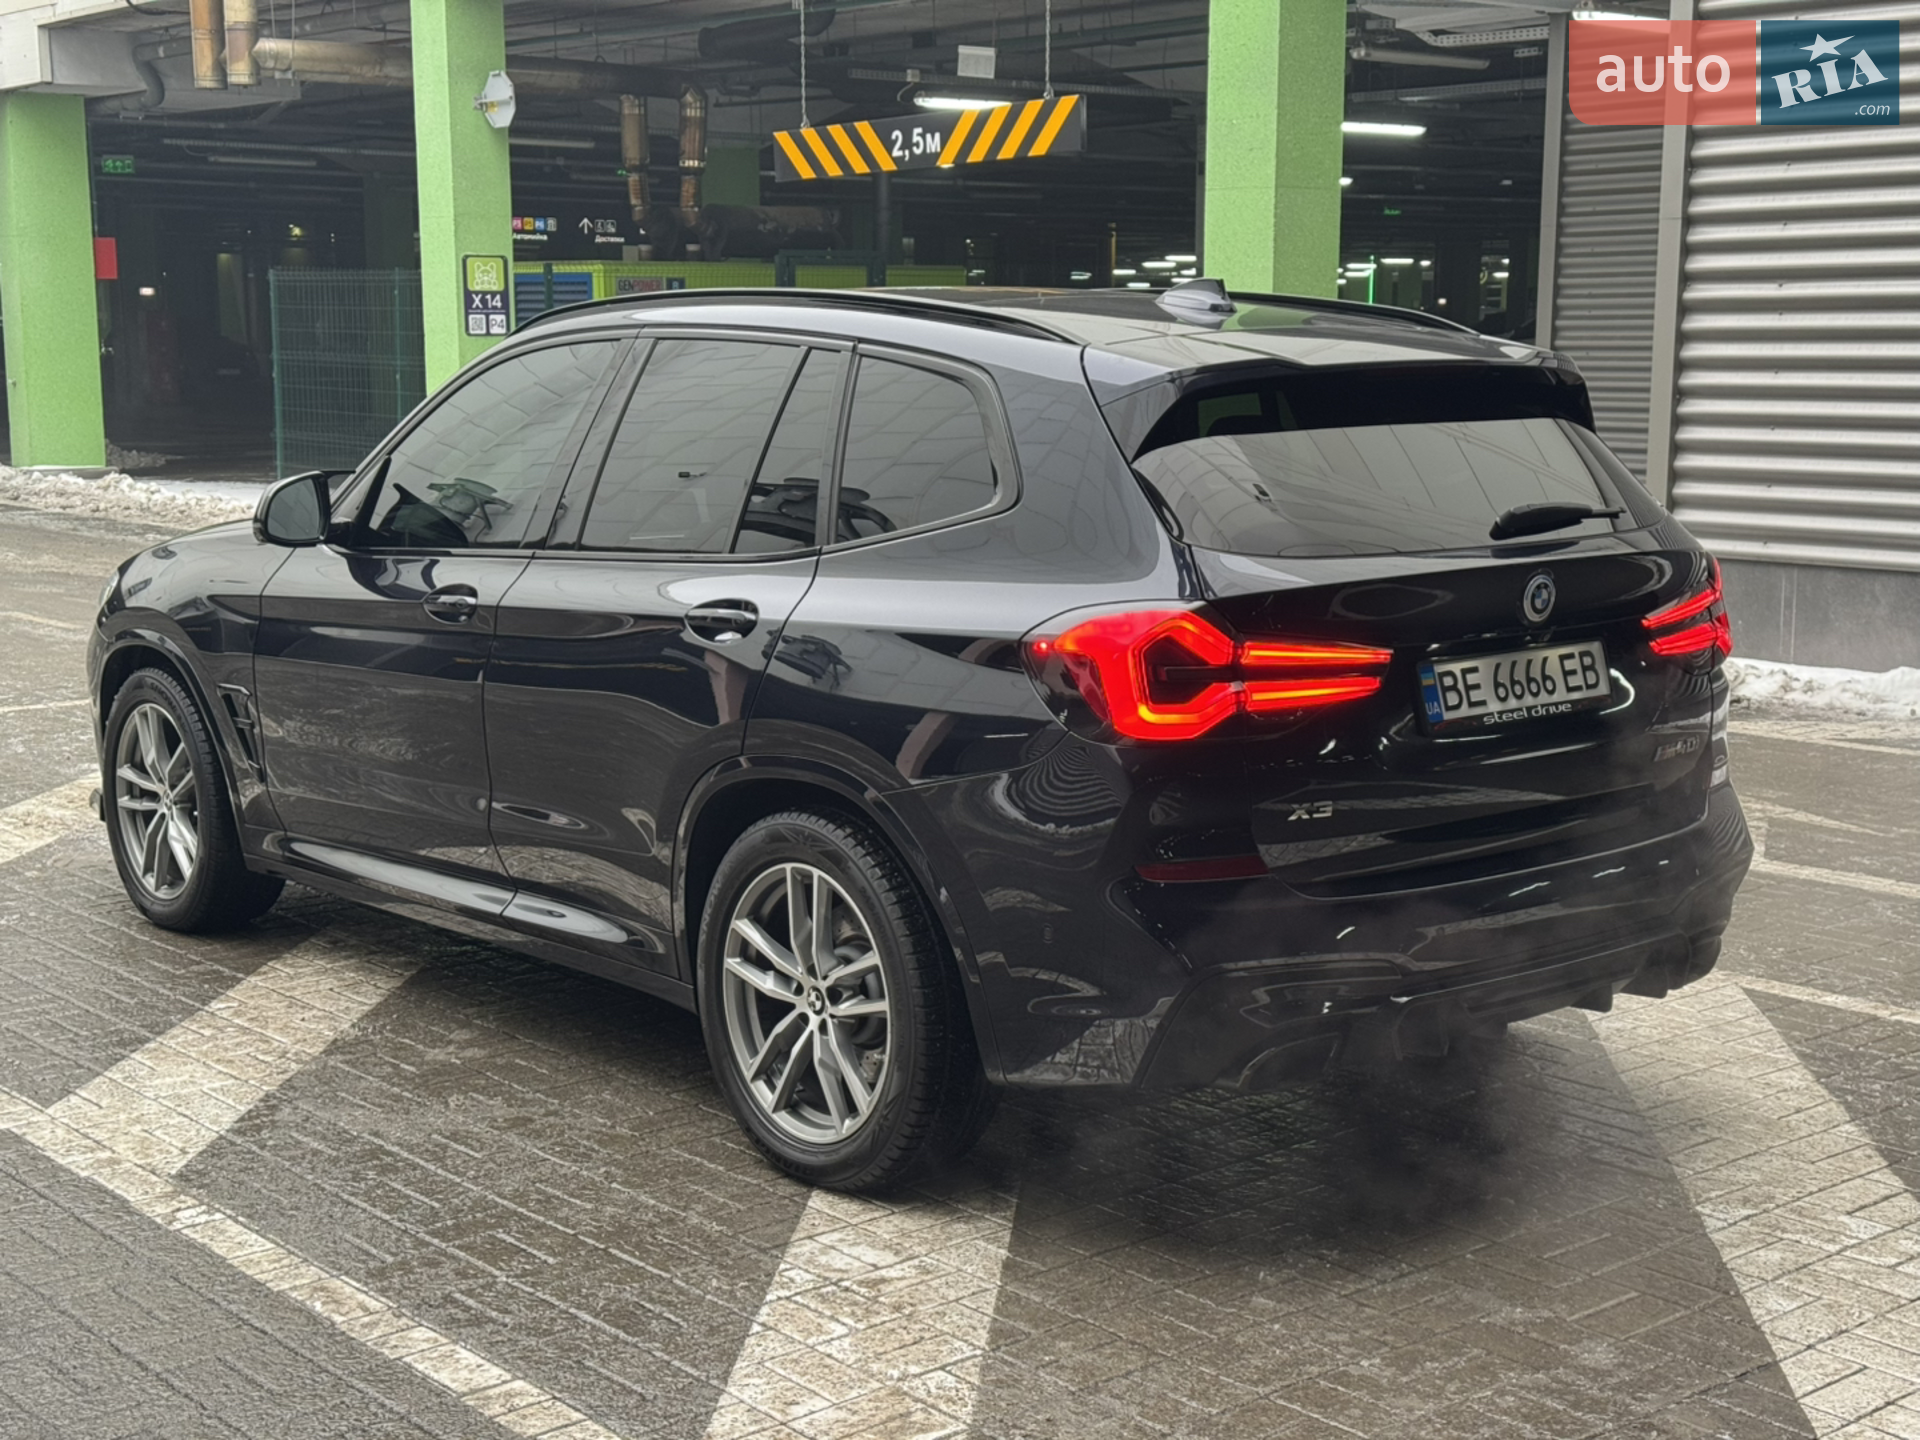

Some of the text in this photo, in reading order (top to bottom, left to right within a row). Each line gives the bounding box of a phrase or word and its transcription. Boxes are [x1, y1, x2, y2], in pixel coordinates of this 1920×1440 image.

[485, 293, 502, 309] 14
[490, 318, 505, 330] P4
[1438, 650, 1600, 713] BE 6666 EB
[1425, 701, 1441, 716] UA
[1483, 703, 1572, 725] steel drive
[1287, 800, 1333, 821] X3
